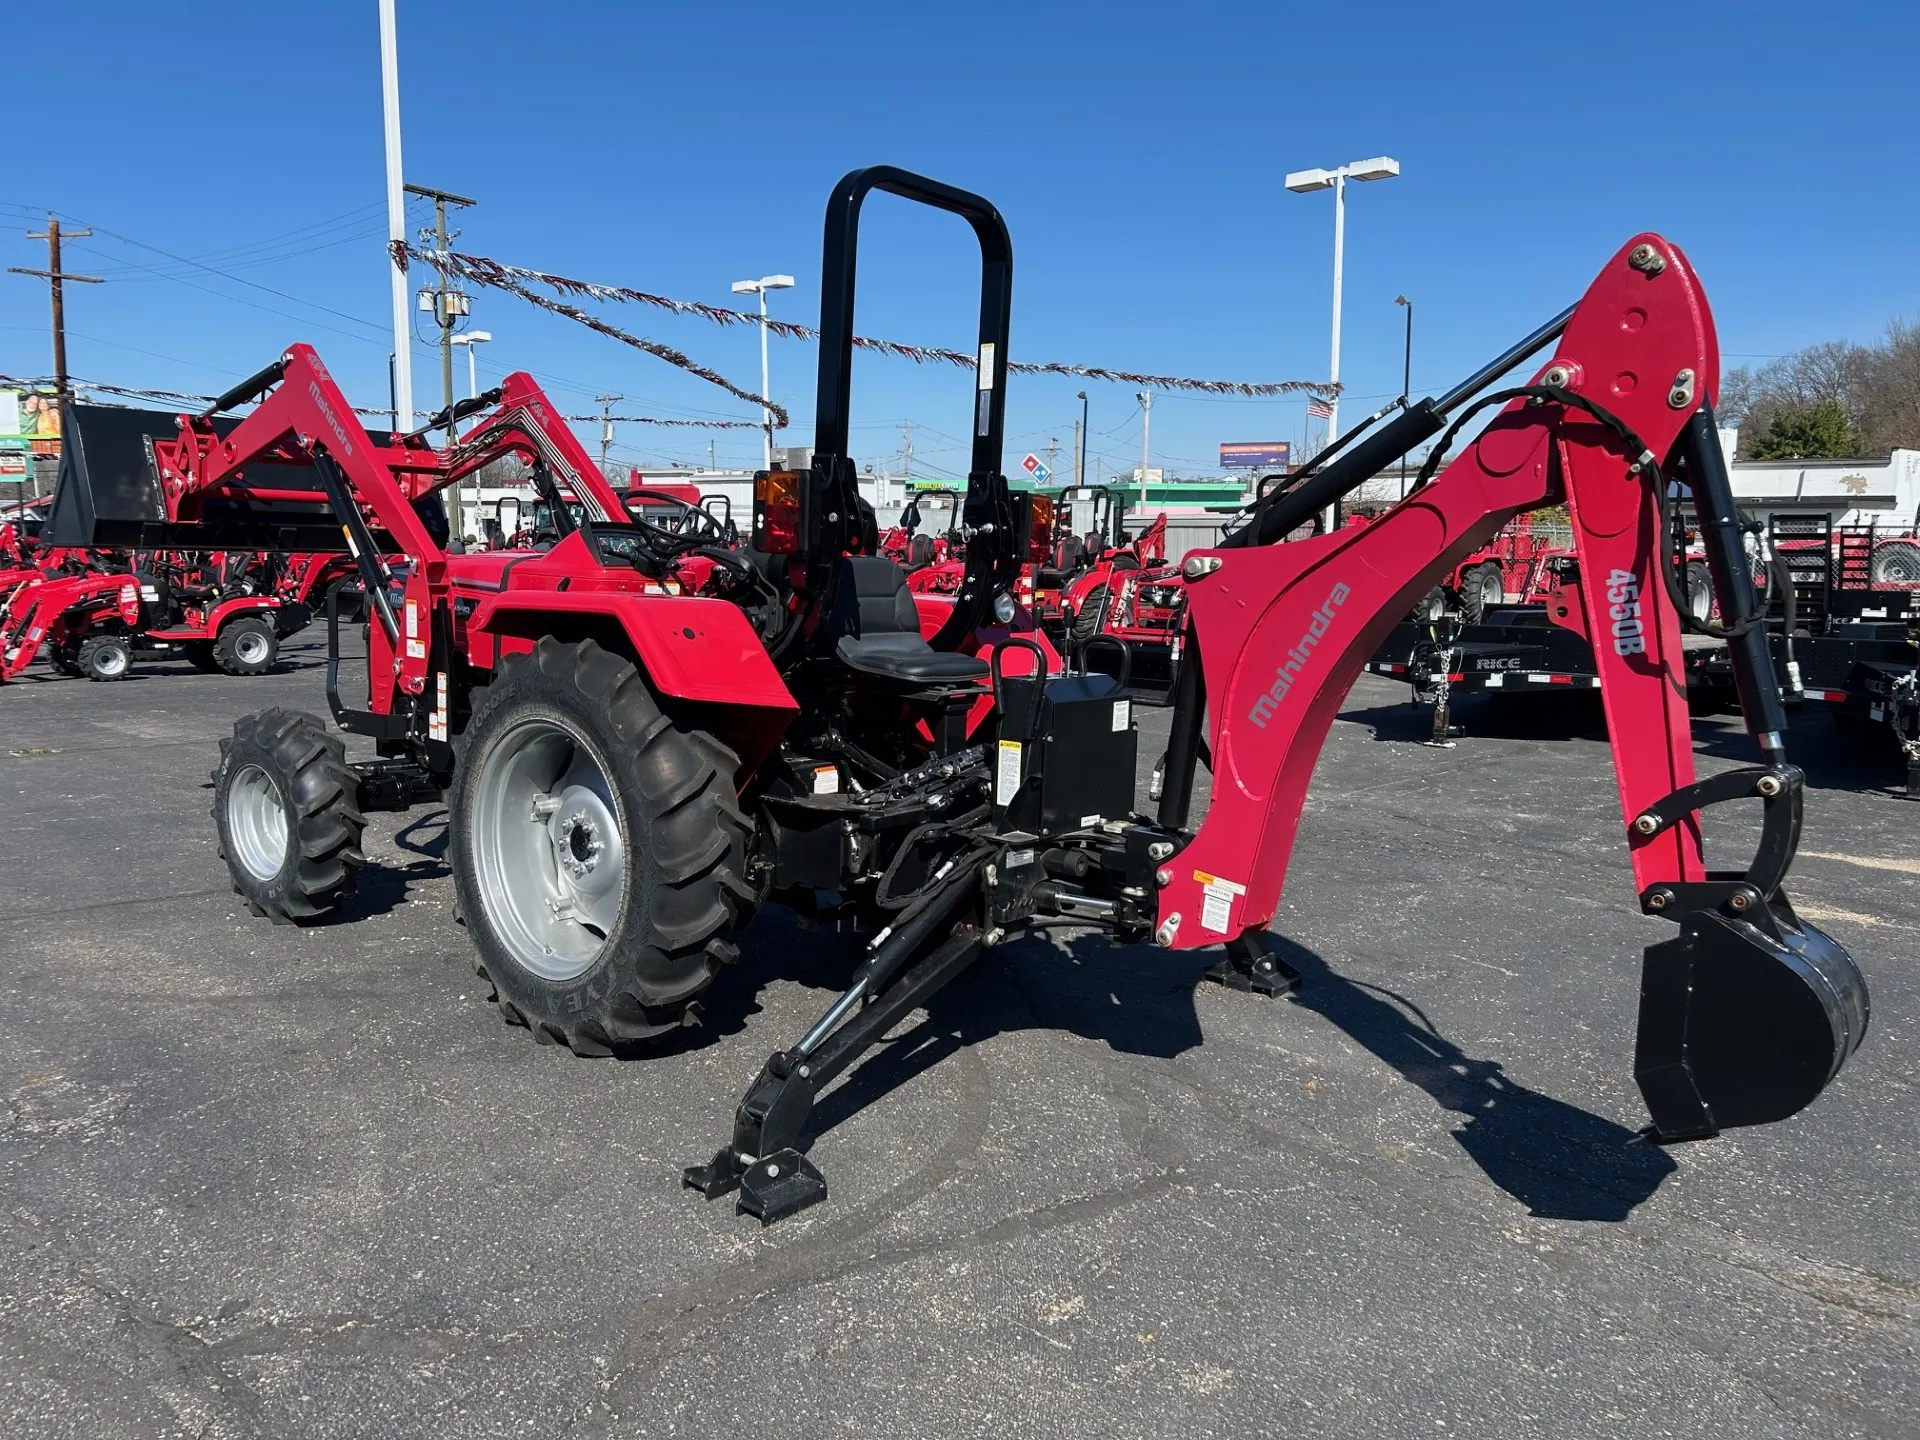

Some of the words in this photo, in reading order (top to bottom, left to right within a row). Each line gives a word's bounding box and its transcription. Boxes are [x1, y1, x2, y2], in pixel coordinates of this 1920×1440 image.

[308, 381, 353, 456] Mahindra
[1605, 568, 1646, 656] 4550B
[1248, 581, 1352, 730] Mahindra
[1476, 657, 1520, 670] RICE
